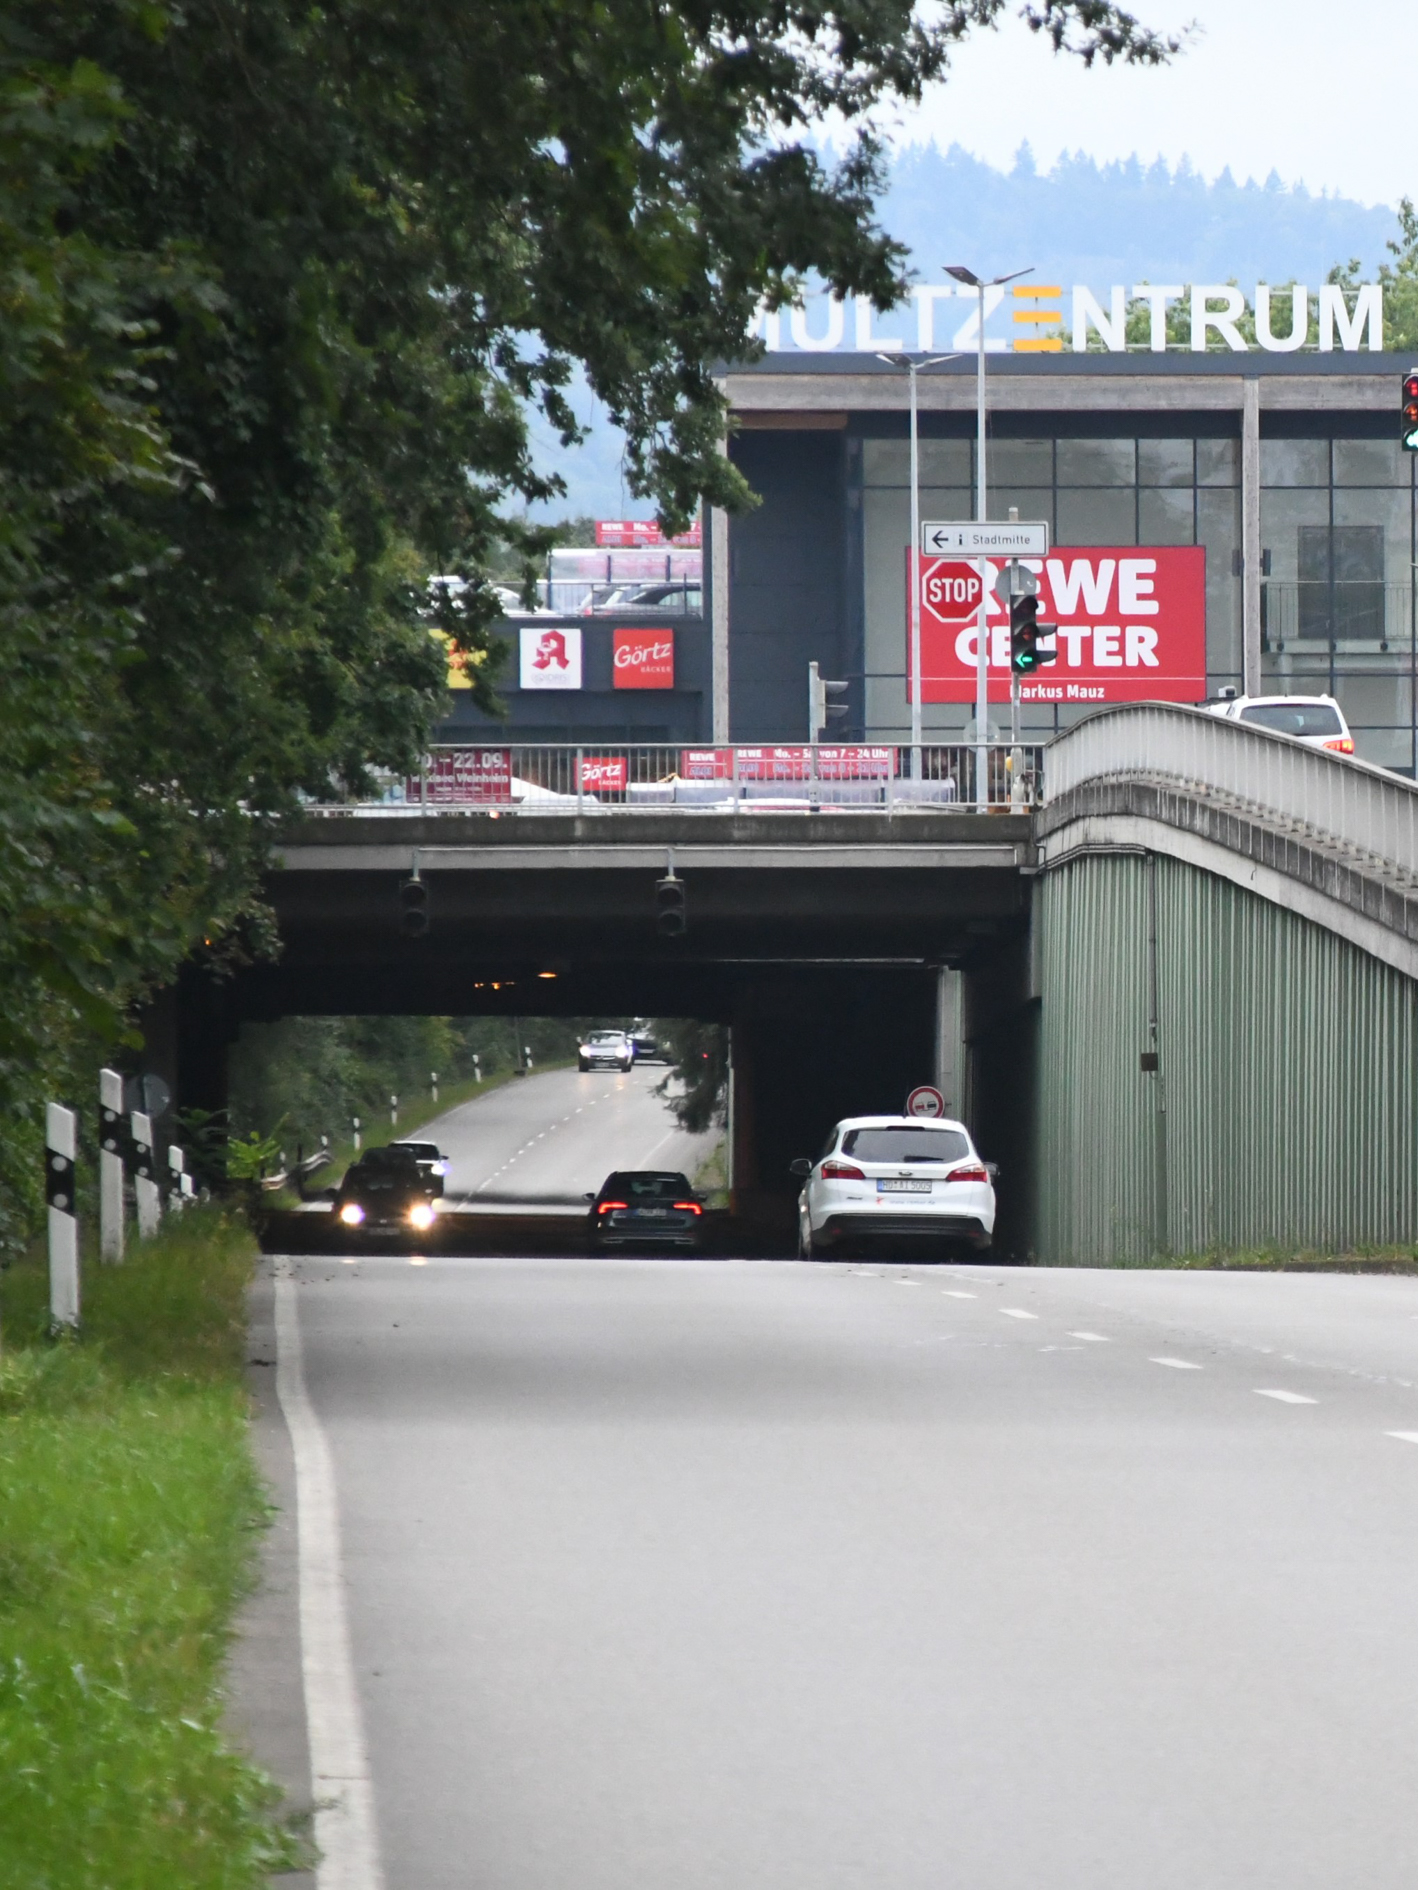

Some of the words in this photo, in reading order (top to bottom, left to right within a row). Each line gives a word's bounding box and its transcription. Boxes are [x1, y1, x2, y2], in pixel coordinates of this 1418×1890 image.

[972, 534, 1031, 546] Stadtmitte
[929, 577, 980, 603] STOP
[613, 642, 672, 668] Görtz
[1066, 684, 1105, 699] Mauz
[453, 752, 508, 769] 22.09.
